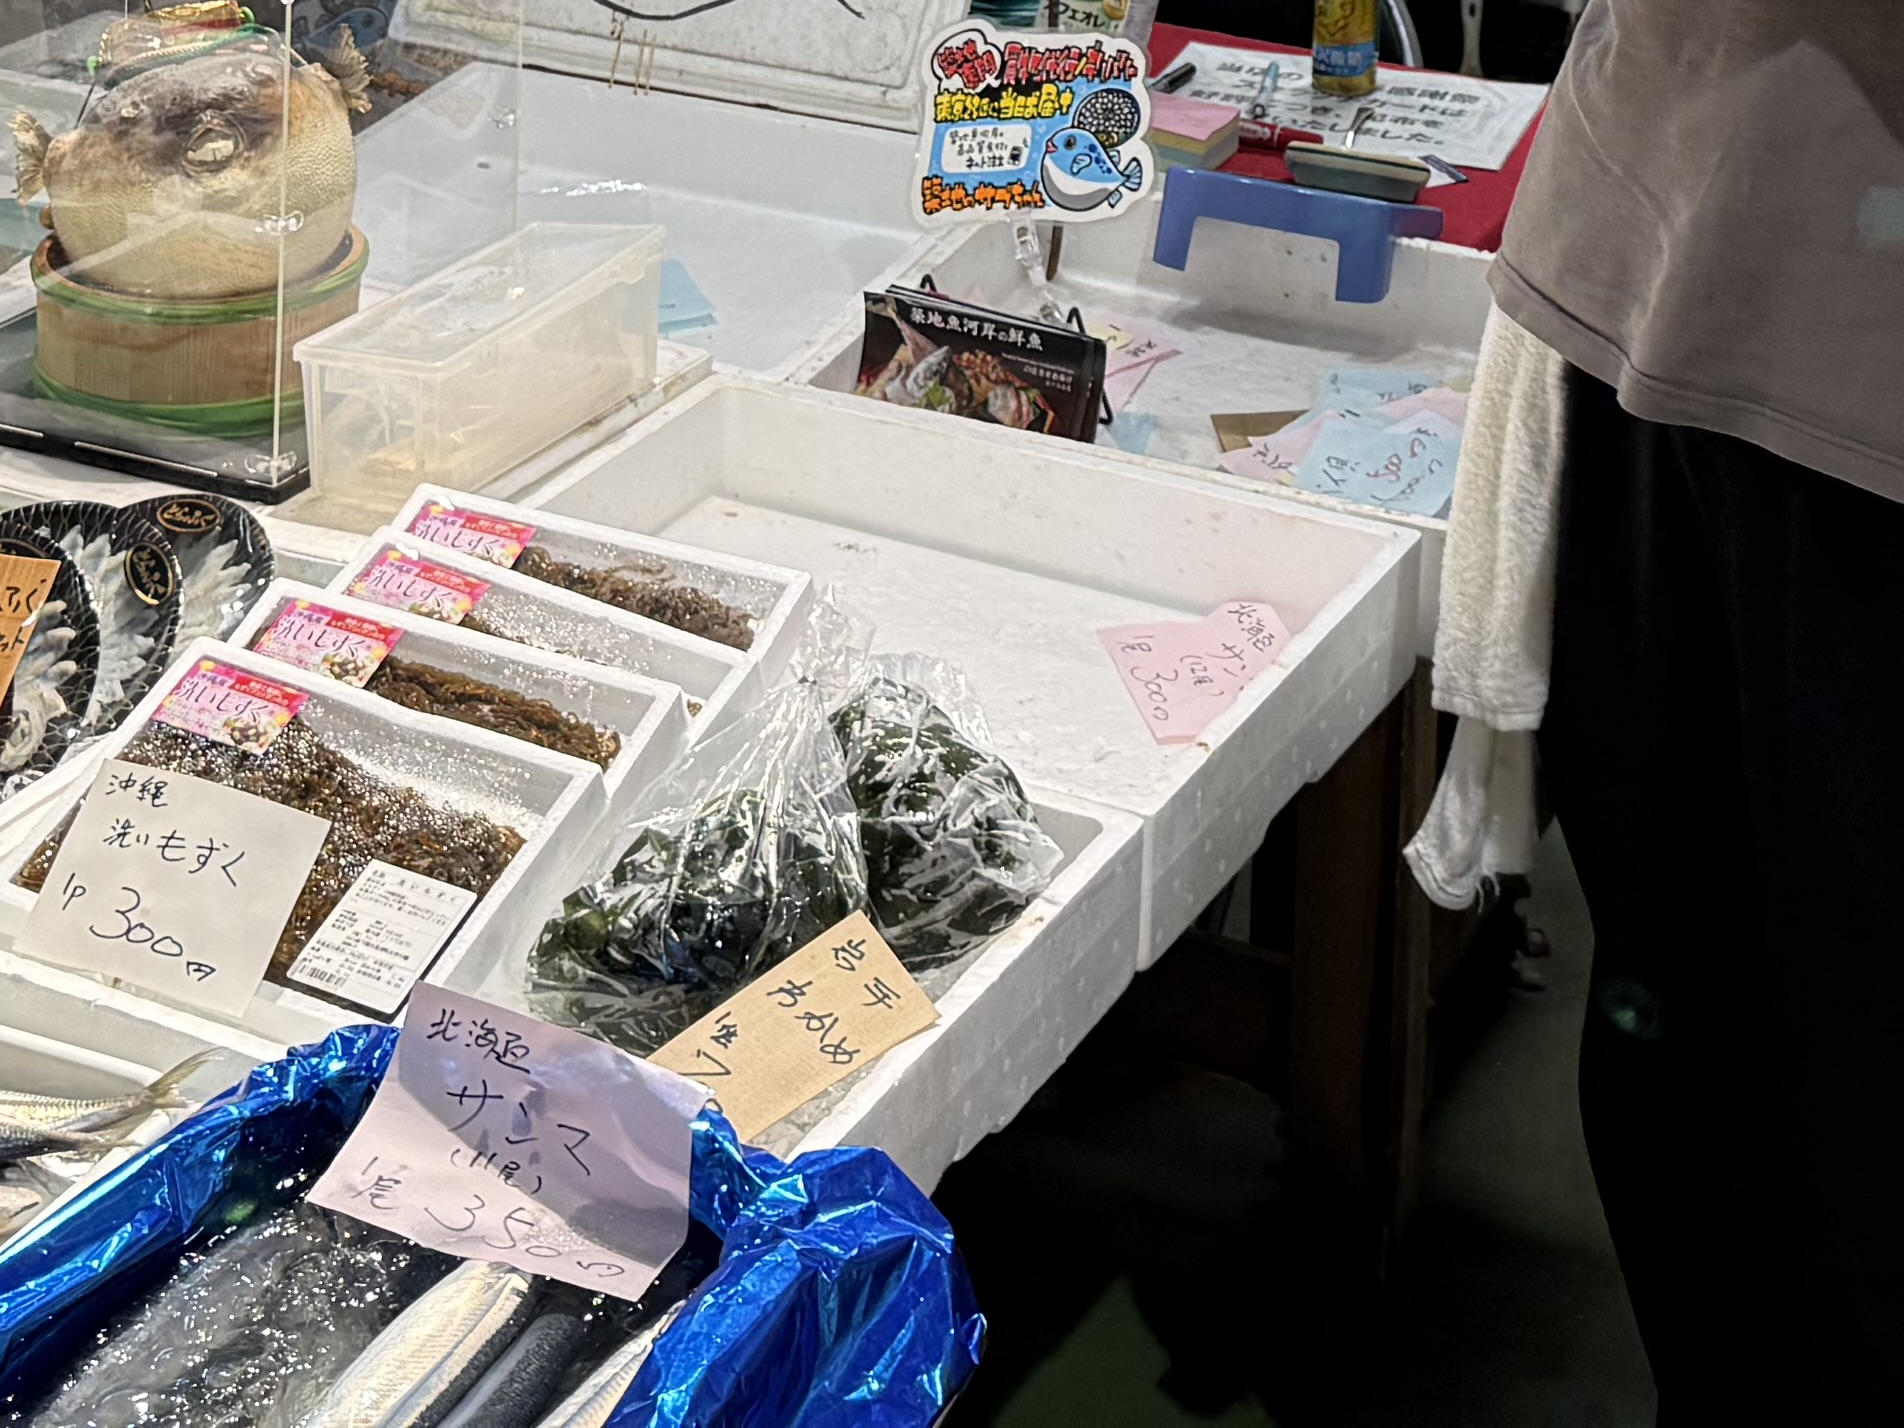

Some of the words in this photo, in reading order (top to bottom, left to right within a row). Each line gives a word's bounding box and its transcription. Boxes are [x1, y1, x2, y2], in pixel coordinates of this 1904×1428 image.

[104, 772, 169, 808] 沖縄
[103, 817, 246, 887] 洗いもずく
[89, 886, 216, 982] 300円
[427, 1008, 531, 1074] 北海道
[447, 1080, 592, 1176] サンマ
[424, 1194, 625, 1278] 350円
